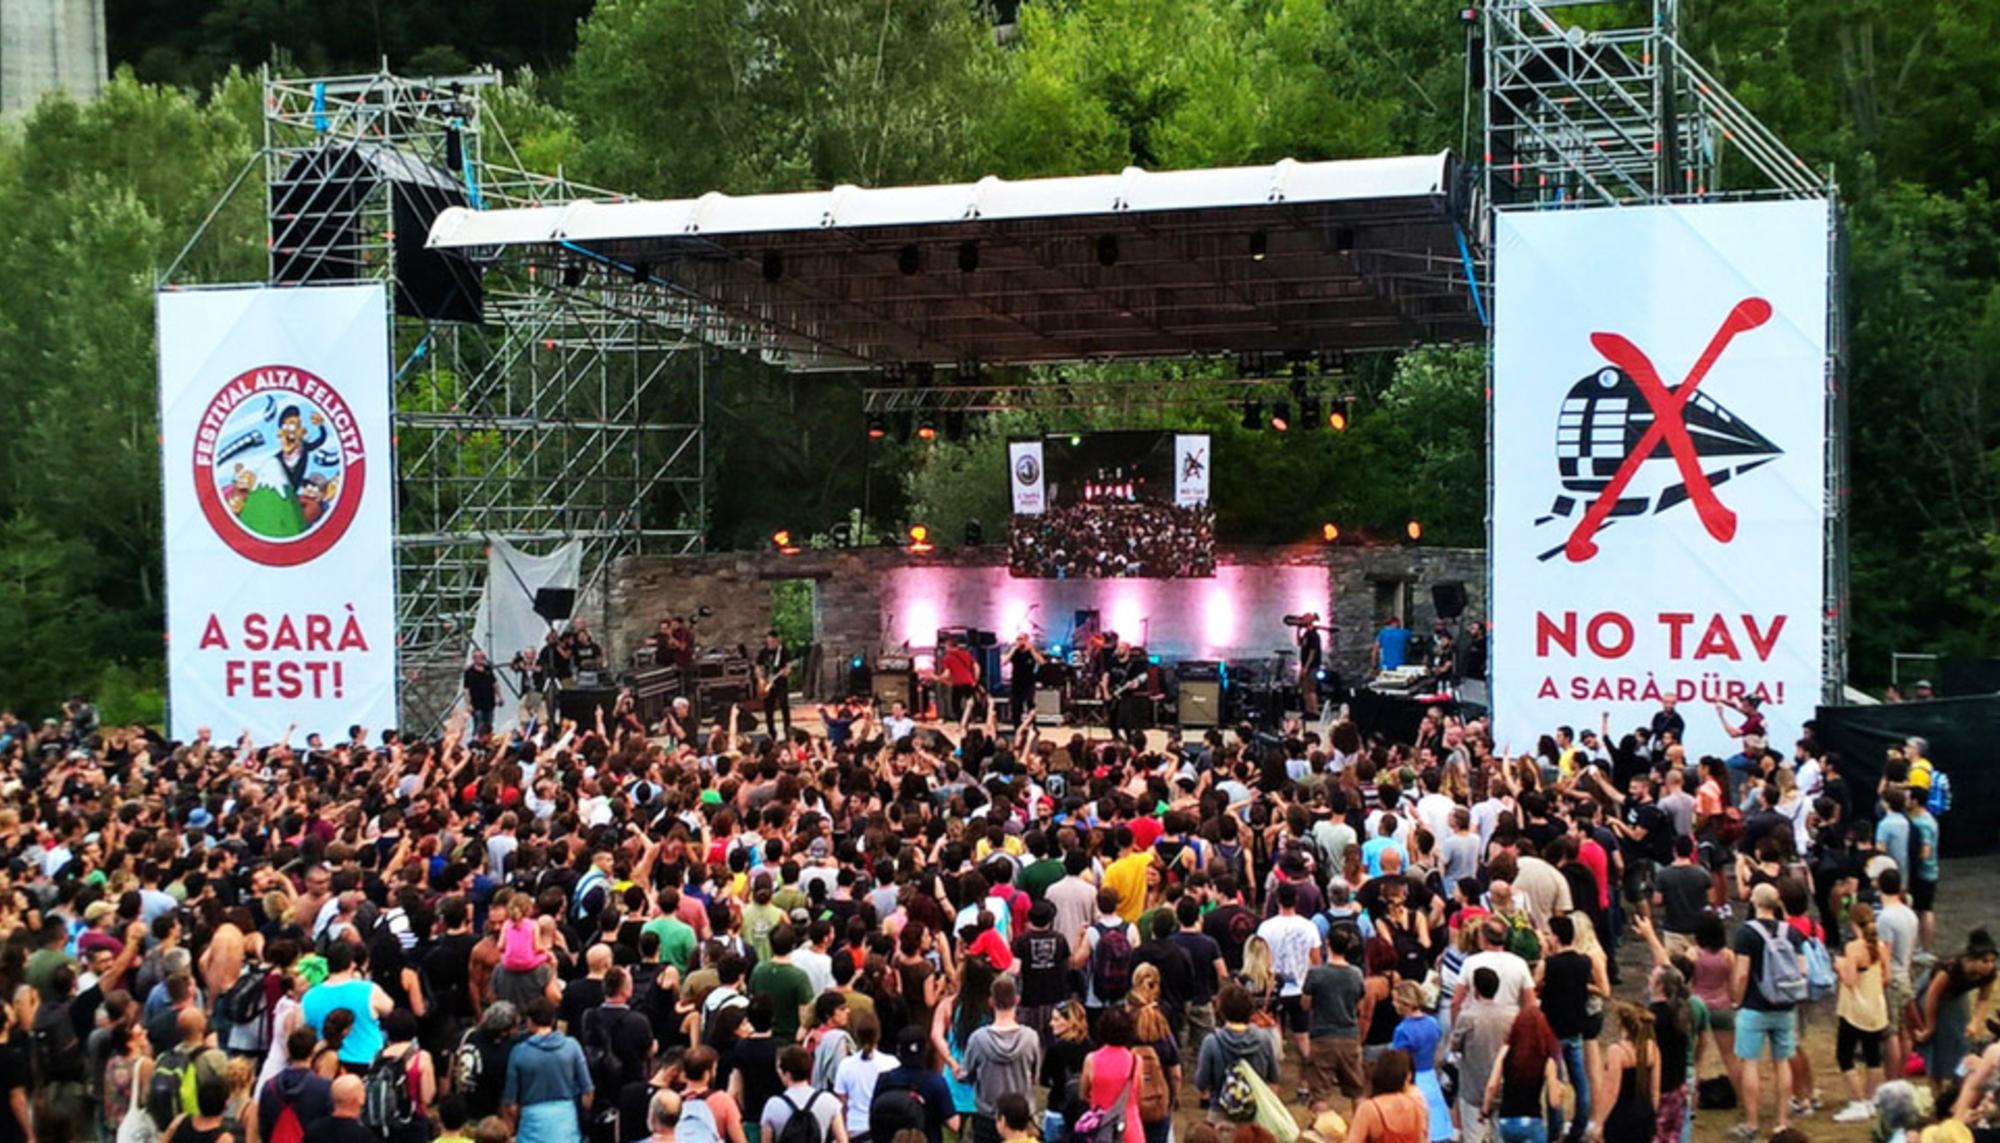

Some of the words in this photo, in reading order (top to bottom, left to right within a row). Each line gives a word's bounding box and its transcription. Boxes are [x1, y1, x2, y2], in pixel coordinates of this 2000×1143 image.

[196, 381, 251, 465] FESTIVAL
[255, 371, 300, 390] ALTA
[303, 380, 365, 466] FELICITÀ
[199, 613, 230, 650] A
[243, 603, 369, 651] SARÀ
[1536, 611, 1635, 659] NO
[1658, 613, 1787, 662] TAV
[226, 660, 343, 699] FEST!
[1537, 676, 1560, 699] A
[1570, 671, 1662, 701] SARÀ
[1676, 672, 1784, 705] DÜRA!
